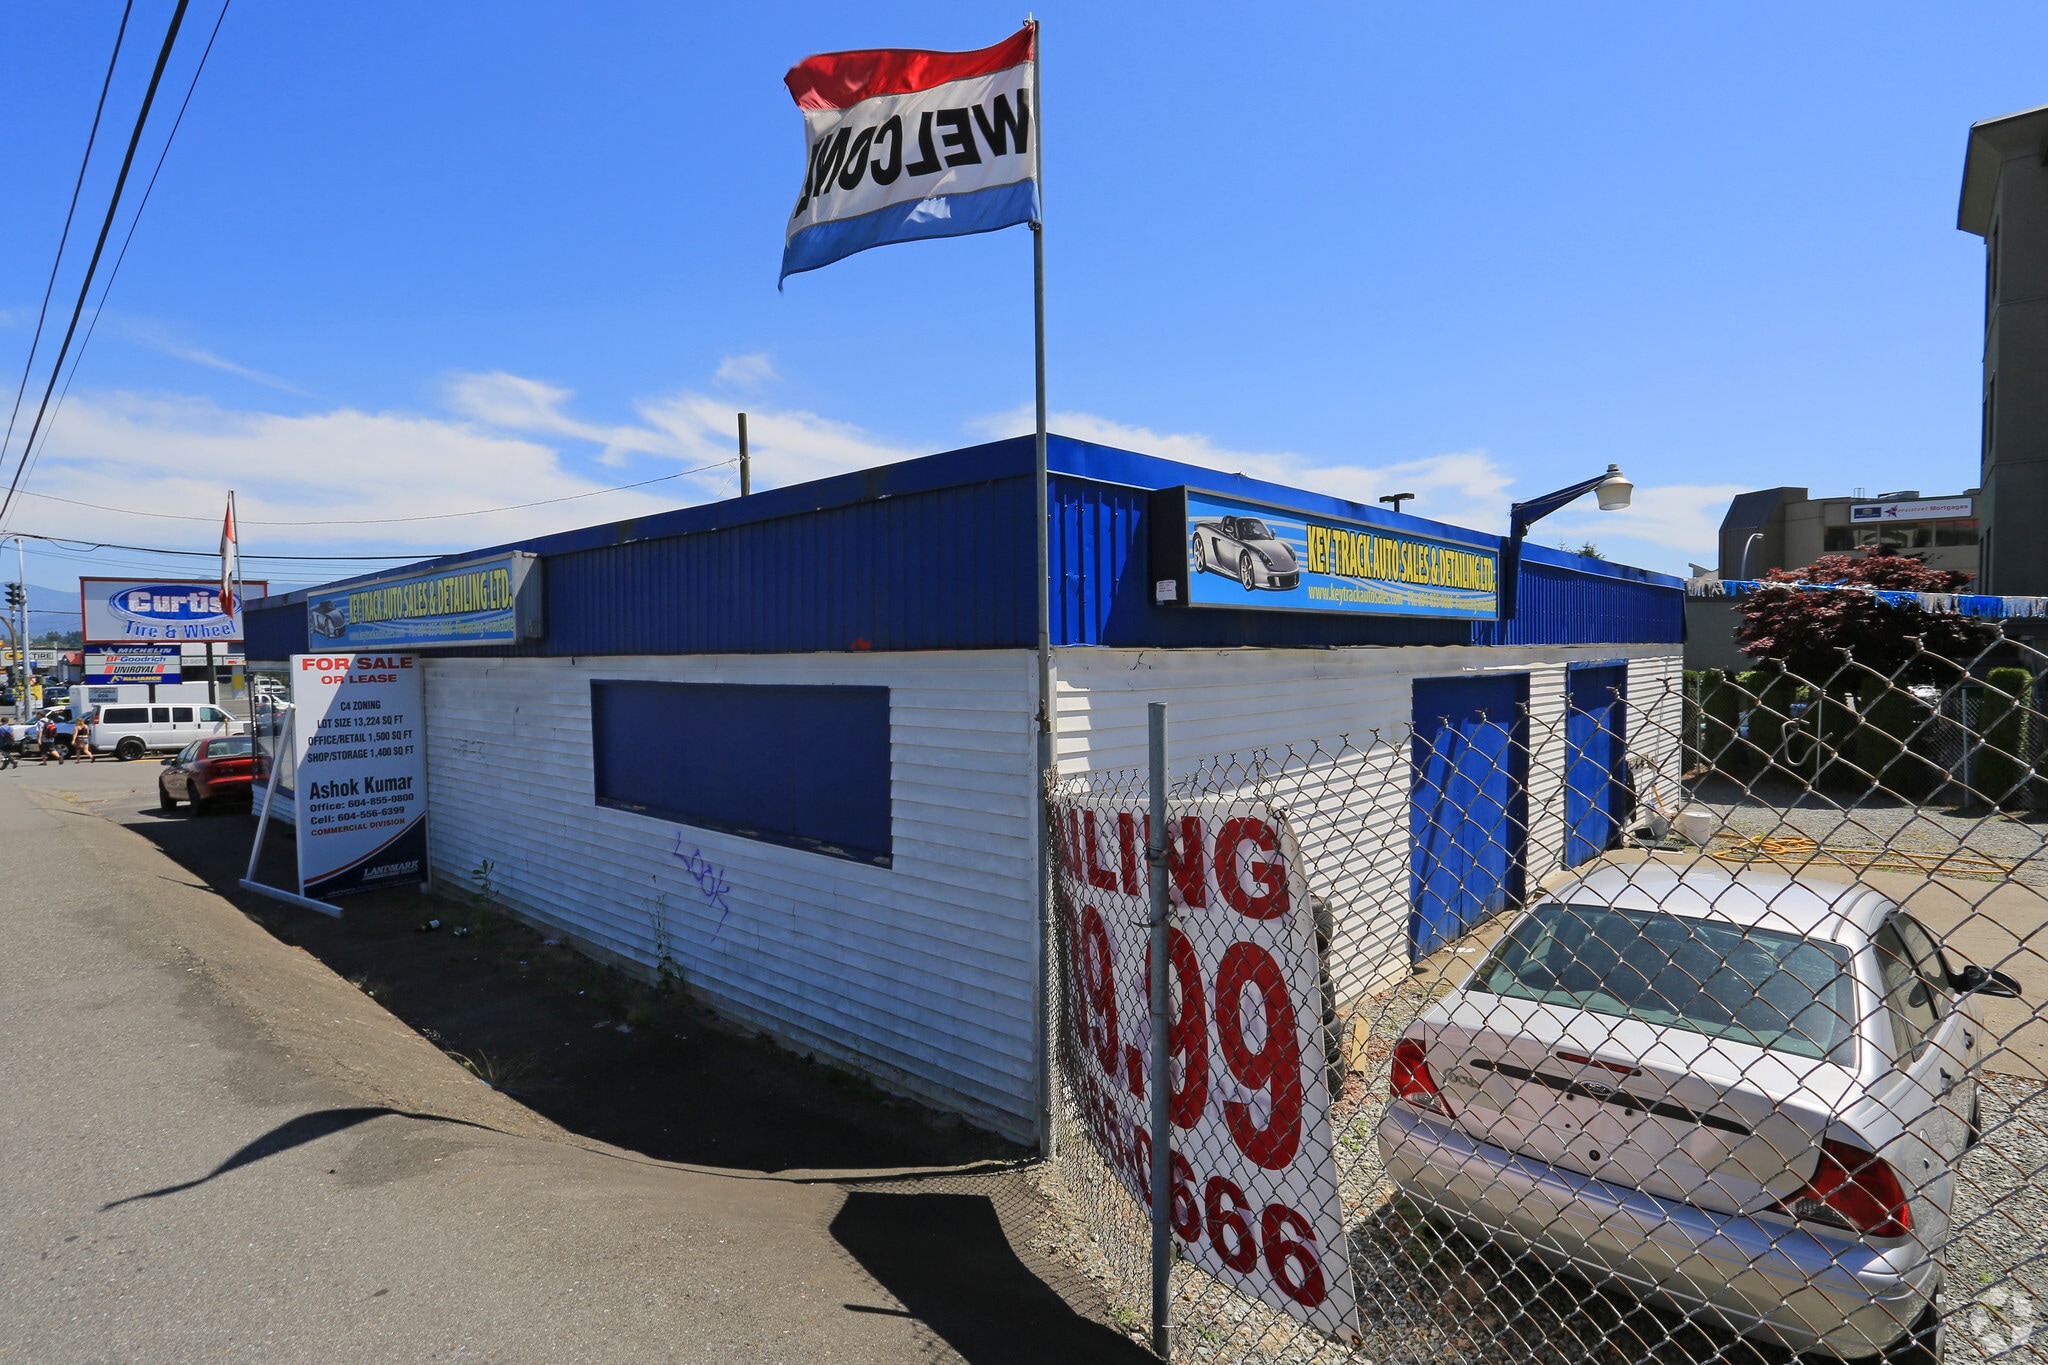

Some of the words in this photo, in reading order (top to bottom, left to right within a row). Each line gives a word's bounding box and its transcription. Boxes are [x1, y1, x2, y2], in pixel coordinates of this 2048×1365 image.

[1930, 504, 1968, 512] Mortgages
[1306, 524, 1331, 575] KEY
[1333, 528, 1372, 578] TRACK
[1373, 535, 1399, 582] AUTO
[1400, 541, 1429, 585] SALES
[1431, 546, 1438, 586] &
[1439, 547, 1480, 590] DETAILING
[1480, 556, 1497, 593] LTD.
[128, 591, 221, 613] Curtis
[349, 592, 360, 624] KEY
[361, 589, 382, 622] TRACK
[383, 585, 402, 620] AUTO
[404, 581, 428, 618] SALES
[429, 579, 437, 616] &
[437, 570, 488, 614] DETAILING
[489, 566, 513, 610] LTD.
[125, 620, 158, 638] Tire
[165, 624, 177, 639] &
[184, 620, 236, 638] Wheel
[105, 655, 166, 663] BFGoodrich
[302, 657, 350, 671] FOR
[357, 657, 413, 670] SALE
[113, 665, 155, 674] UNIROYAL
[321, 675, 344, 685] OR
[349, 674, 397, 684] LEASE
[340, 701, 351, 711] C4
[353, 700, 381, 711] ZONING
[317, 718, 332, 729] LOT
[334, 717, 352, 728] SIZE
[354, 716, 381, 728] 13,224
[382, 715, 392, 726] SQ
[394, 714, 403, 724] FT
[308, 733, 366, 746] OFFICE/RETAIL
[368, 731, 390, 743] 1,500
[391, 730, 402, 741] SQ
[403, 730, 412, 739] FT
[307, 748, 368, 763] SHOP/STORAGE
[370, 747, 392, 759] 1,400
[393, 746, 403, 757] SQ
[405, 745, 414, 755] FT
[309, 778, 360, 800] Ashok
[364, 776, 413, 794] Kumar
[310, 801, 345, 813] Office:
[348, 793, 414, 809] 604-855-0800
[310, 814, 335, 825] Cell:
[337, 806, 405, 822] 604-556-6399
[311, 823, 368, 837] COMMERCIAL
[370, 818, 406, 830] DIVISION
[364, 860, 419, 877] LANDMARK
